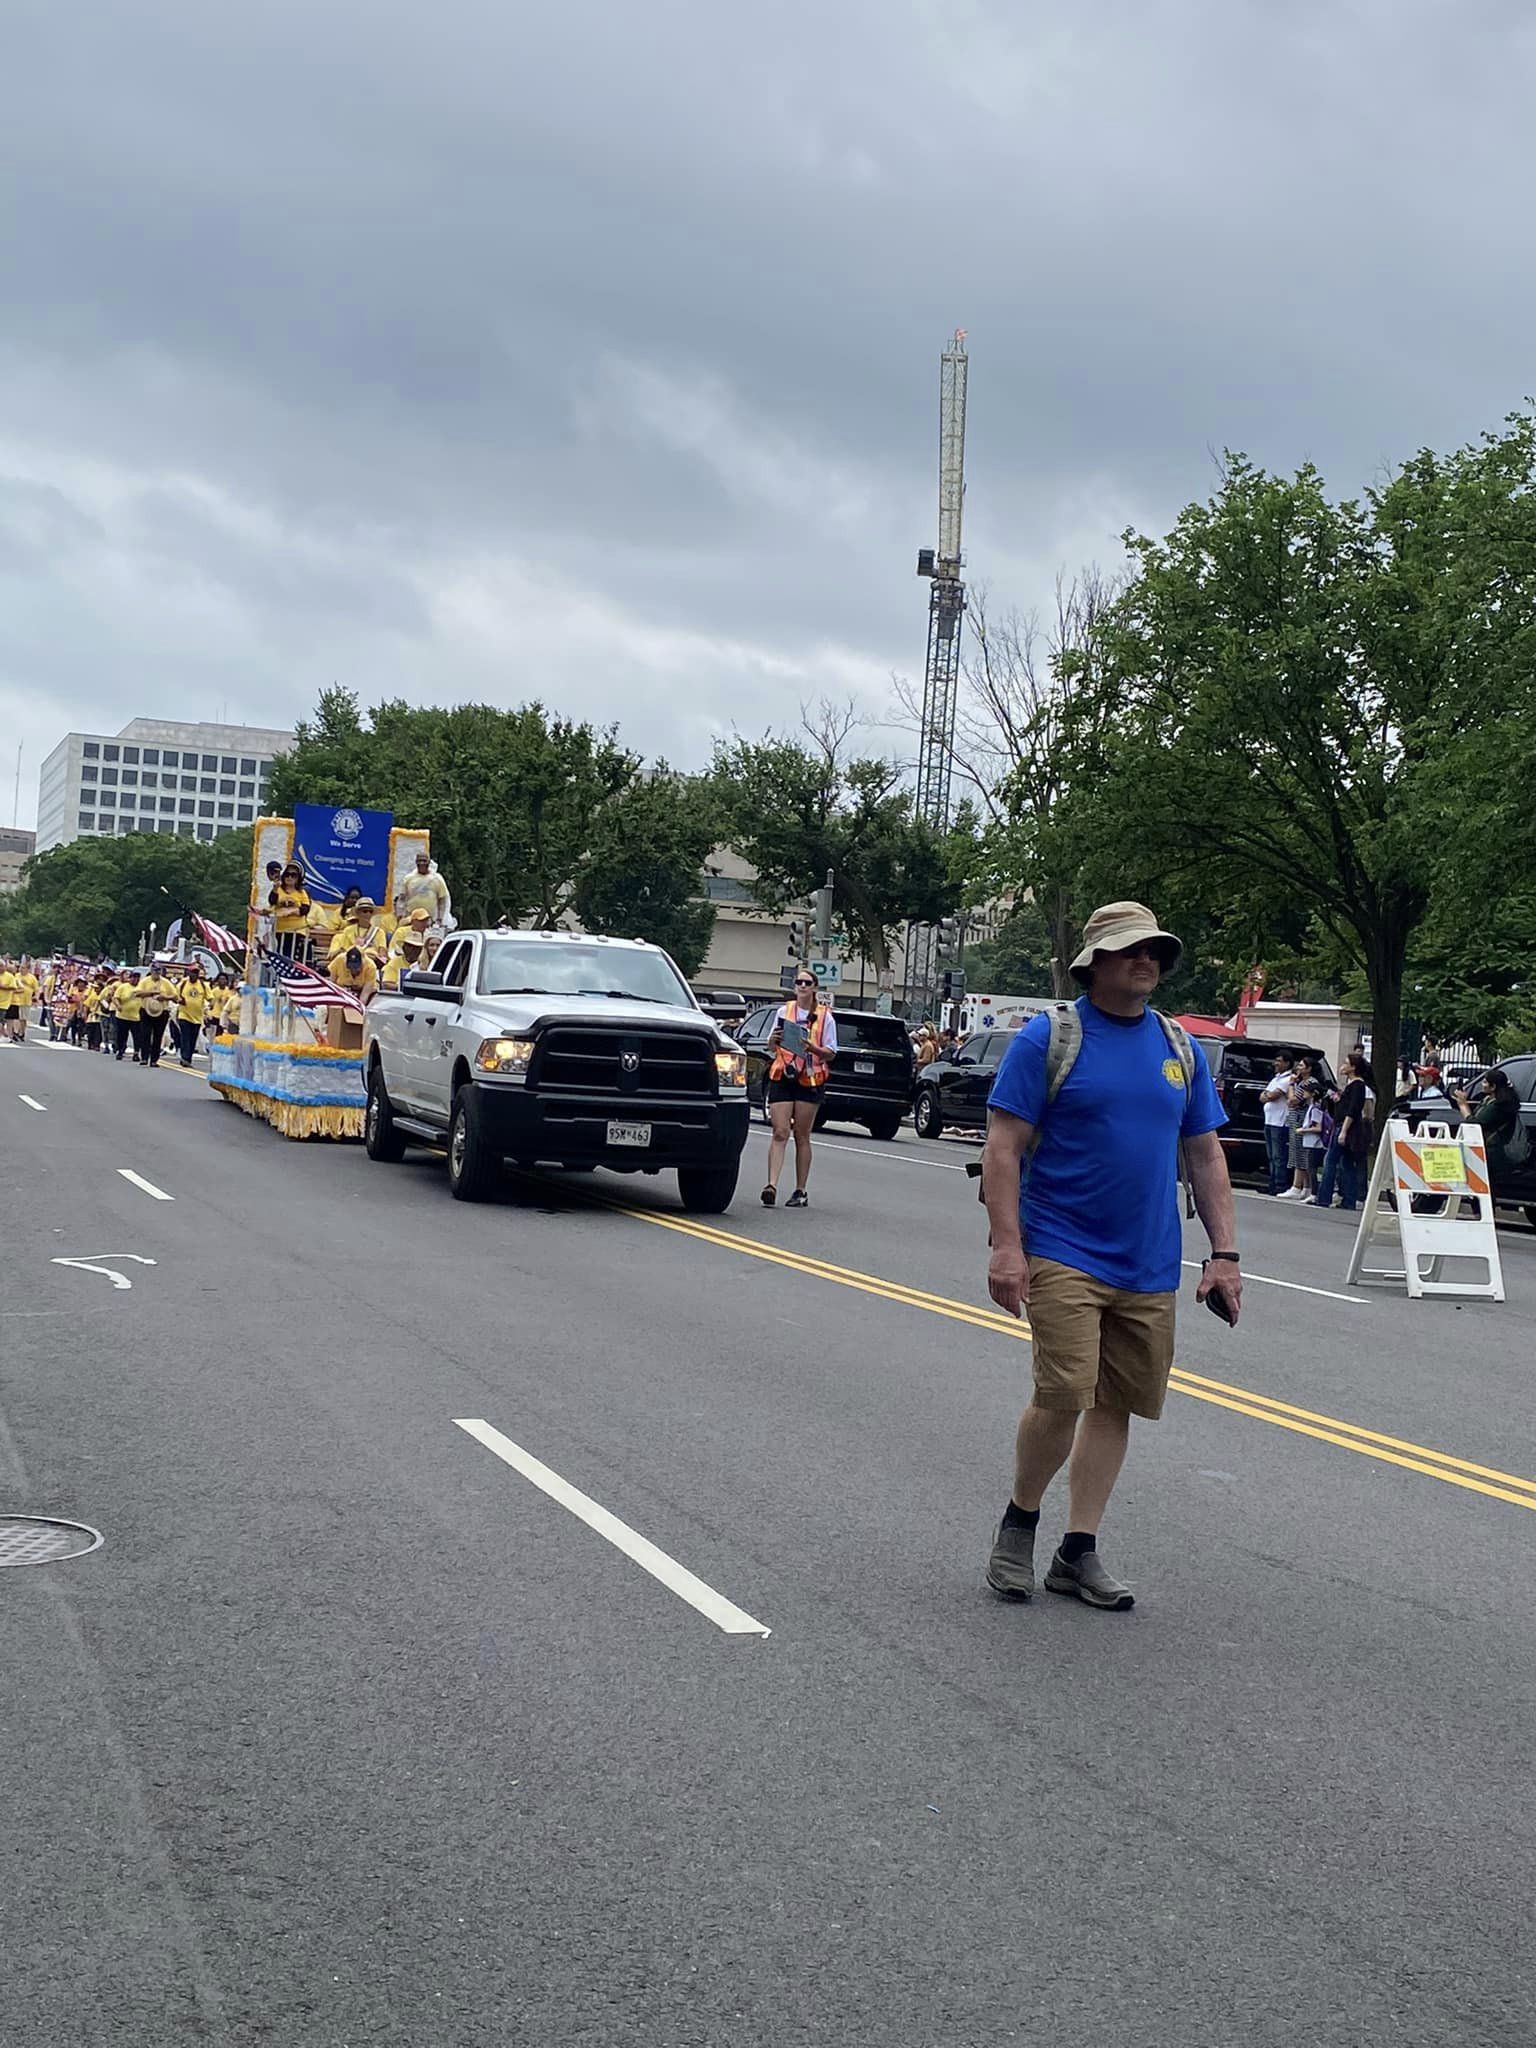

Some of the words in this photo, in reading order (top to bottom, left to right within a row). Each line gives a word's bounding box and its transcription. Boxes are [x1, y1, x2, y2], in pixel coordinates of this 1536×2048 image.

[342, 841, 361, 849] Serve
[314, 854, 344, 865] Changing
[356, 858, 375, 866] World
